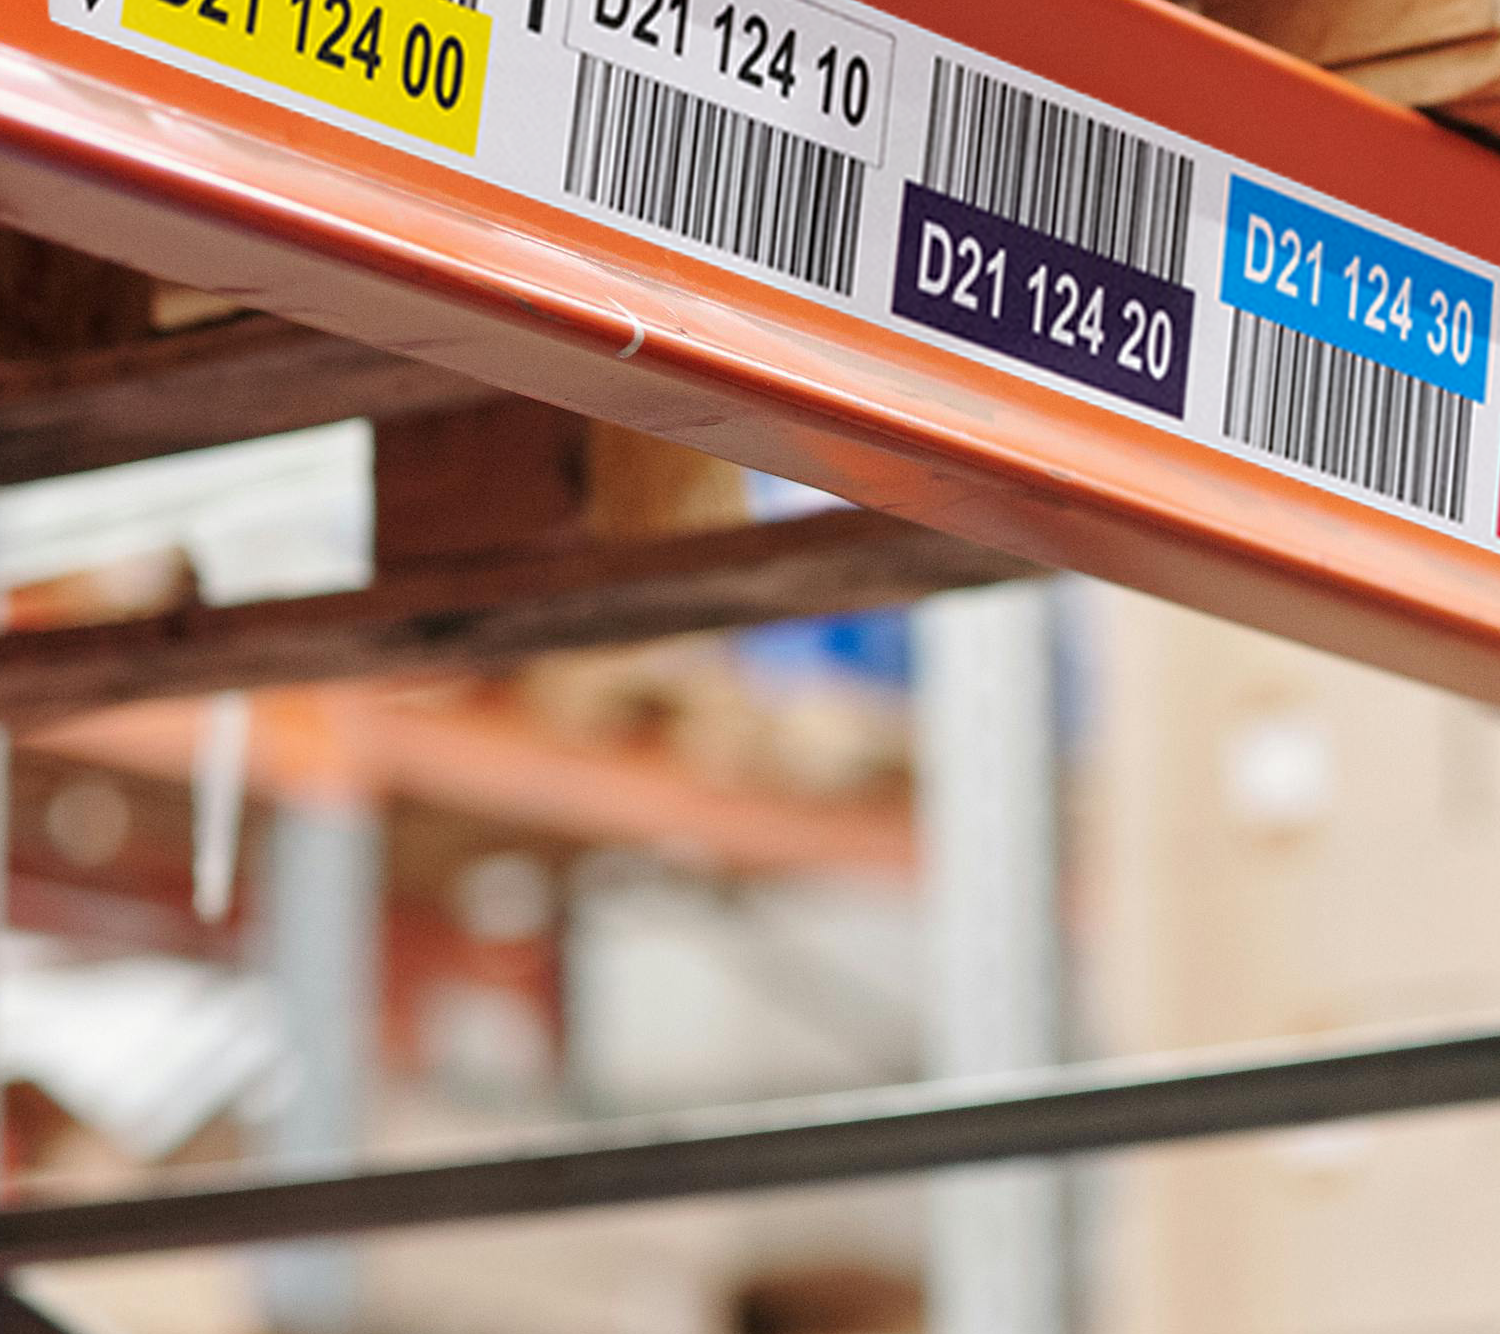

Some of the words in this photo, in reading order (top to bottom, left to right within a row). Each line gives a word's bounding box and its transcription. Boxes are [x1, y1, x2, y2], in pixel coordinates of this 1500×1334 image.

[402, 23, 465, 111] 00
[714, 4, 796, 98] 124
[817, 46, 870, 127] 10
[918, 221, 1006, 318] D21
[1028, 265, 1104, 355] 124
[1117, 300, 1172, 380] 20
[1244, 214, 1323, 306] D21
[1344, 257, 1413, 341] 124
[1427, 290, 1473, 365] 30
